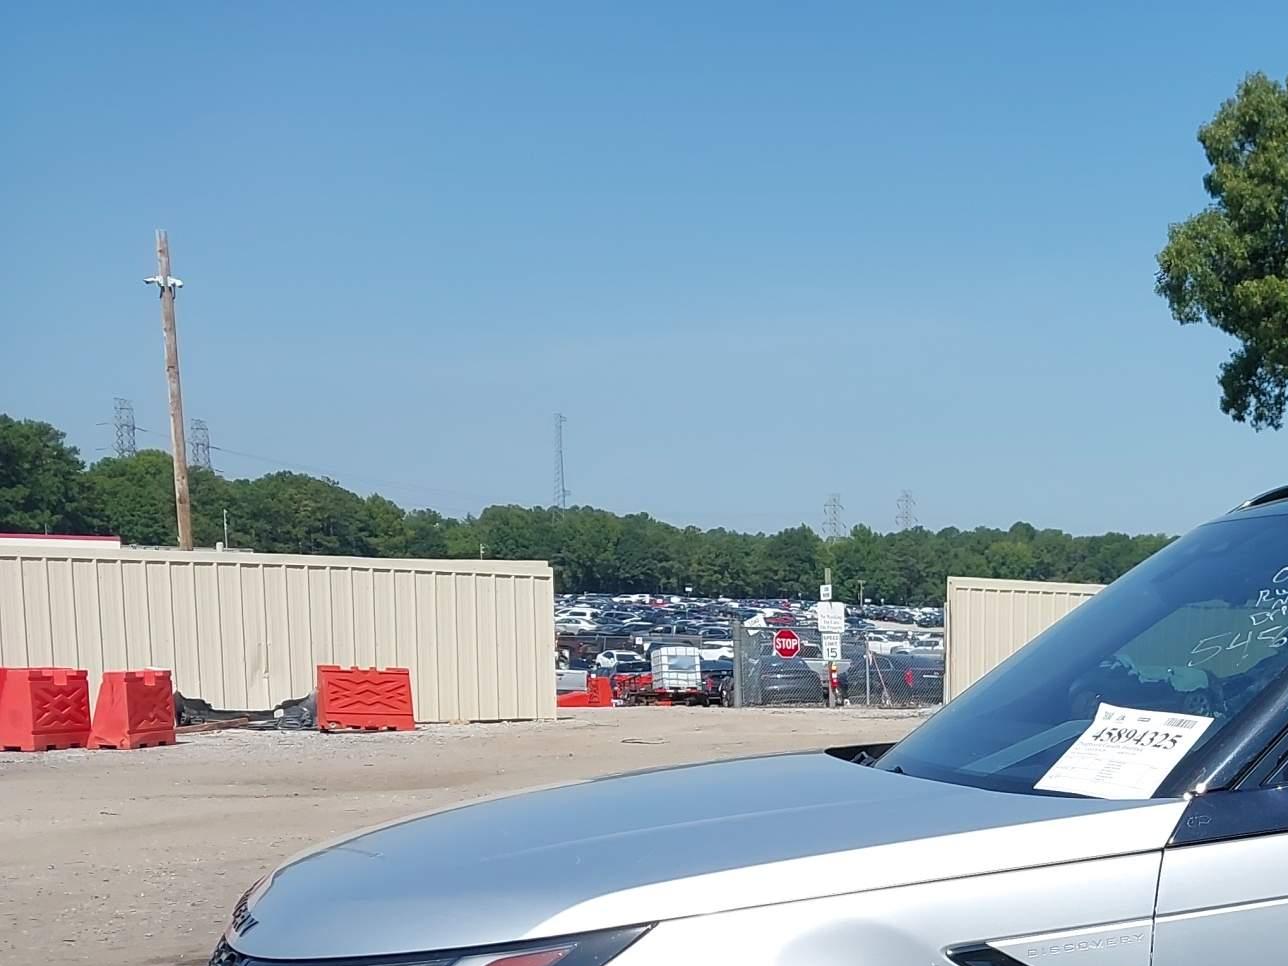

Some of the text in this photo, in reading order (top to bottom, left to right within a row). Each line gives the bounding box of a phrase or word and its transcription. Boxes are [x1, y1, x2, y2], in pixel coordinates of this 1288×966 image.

[775, 638, 798, 650] STOP
[826, 648, 838, 658] 15
[1092, 726, 1184, 751] 45894325
[1026, 932, 1146, 959] DISCOVERY
